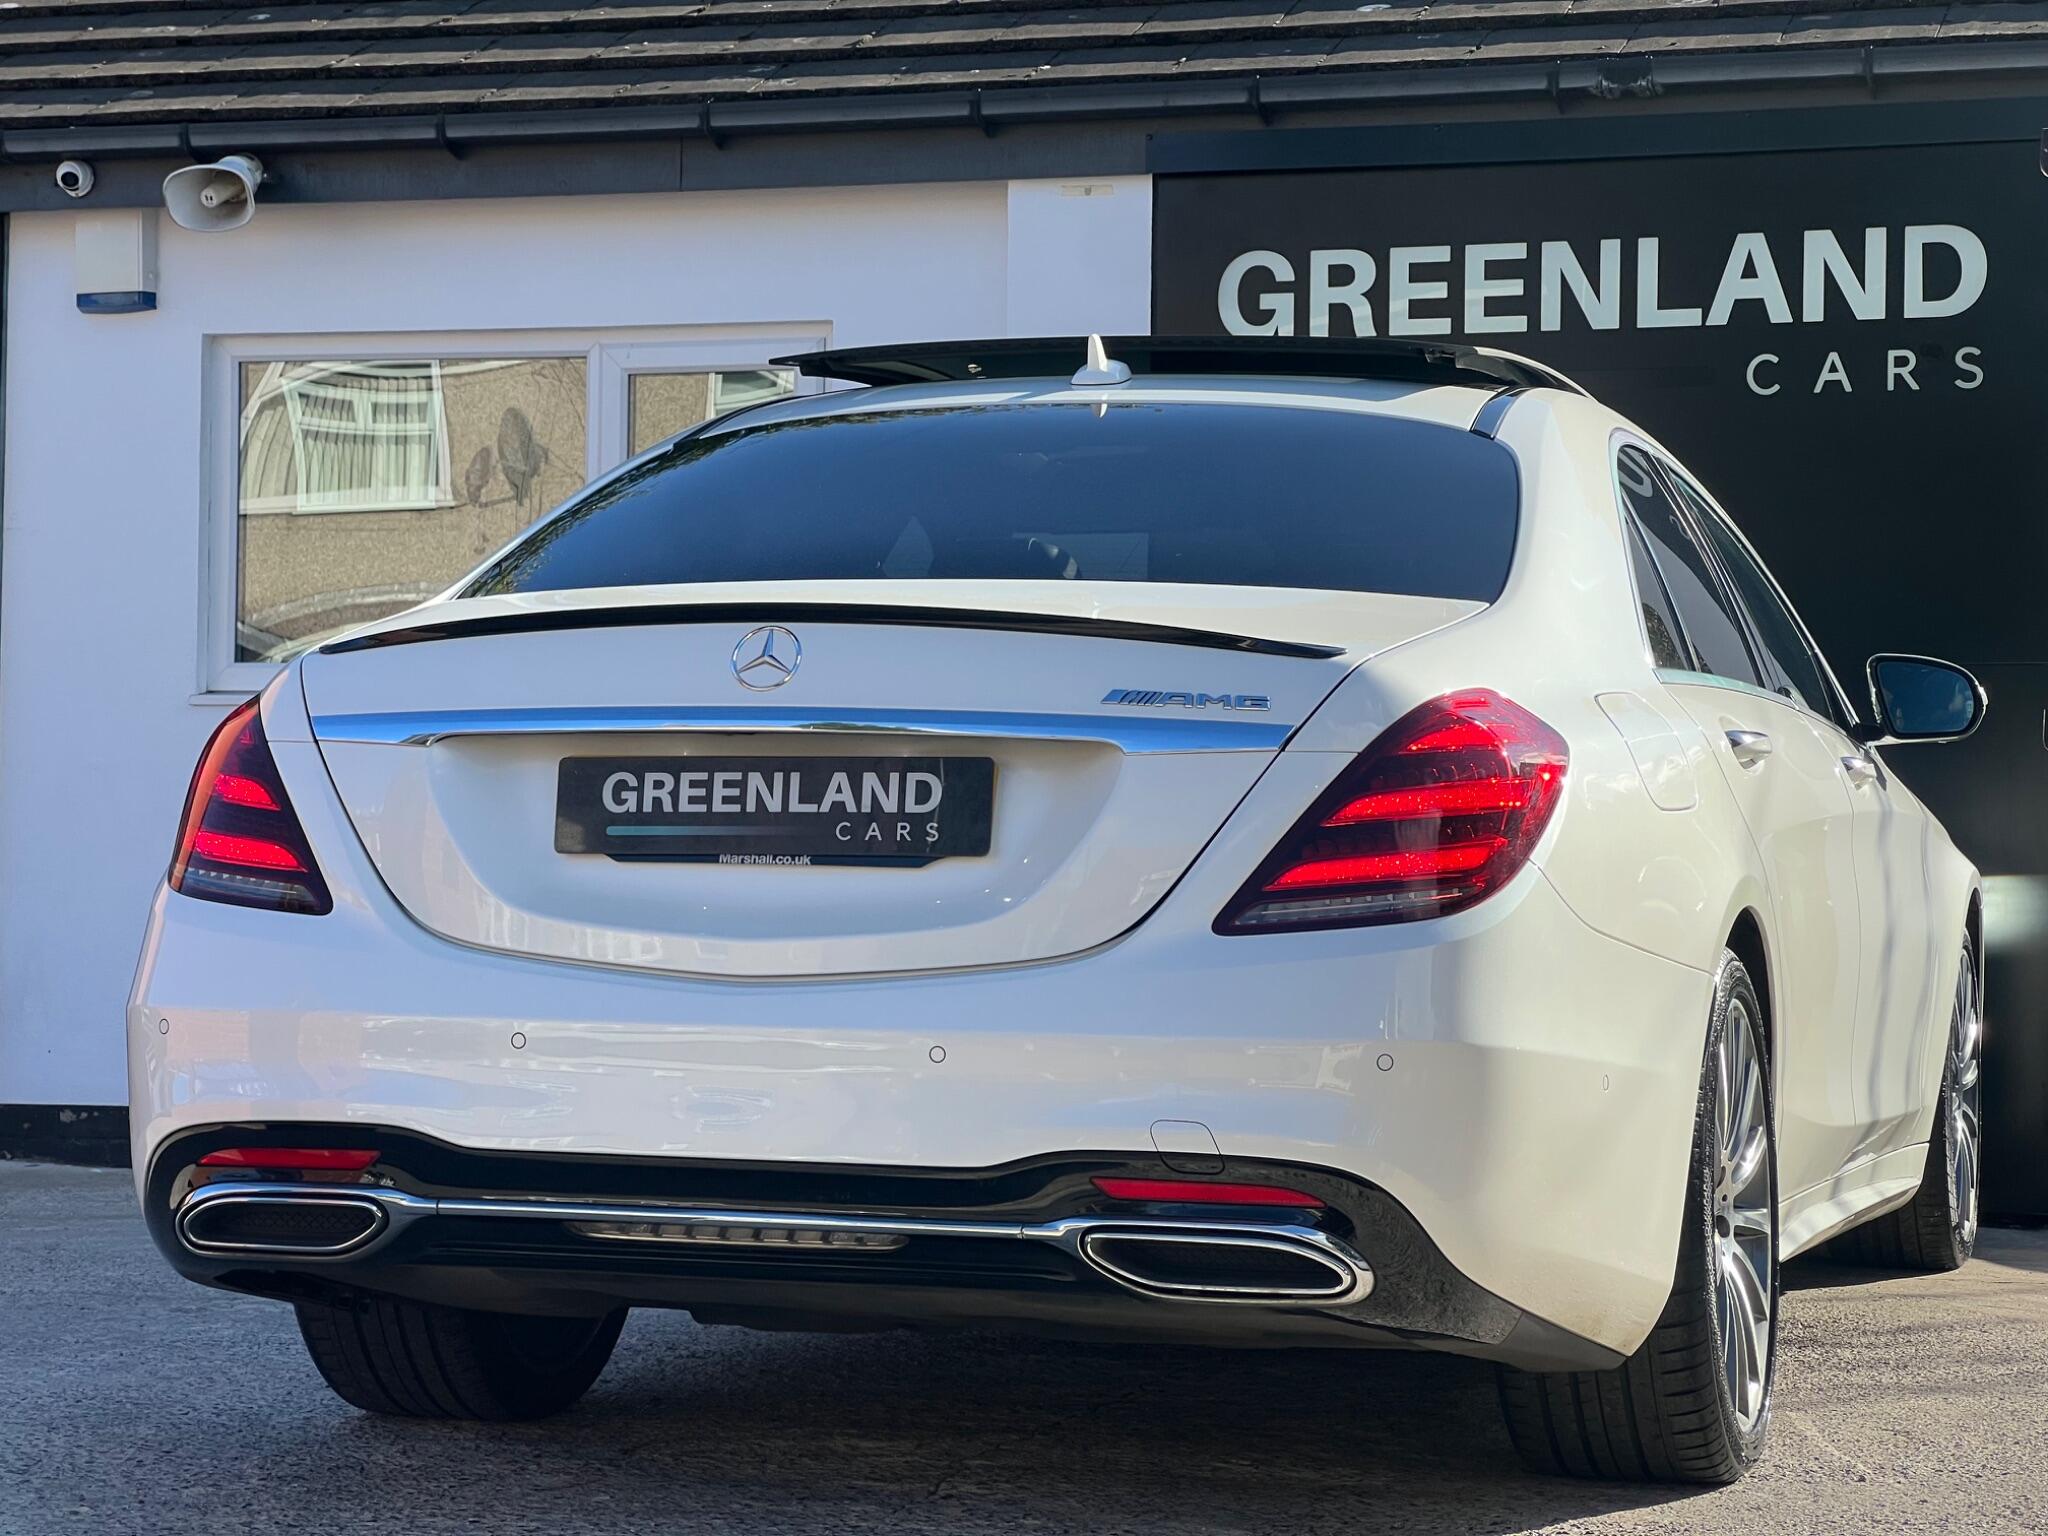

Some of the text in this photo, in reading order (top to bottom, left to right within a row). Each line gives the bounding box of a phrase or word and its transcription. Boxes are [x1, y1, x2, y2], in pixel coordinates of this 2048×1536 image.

[1217, 224, 1988, 336] GREENLAND
[1746, 346, 1985, 396] CARS
[1155, 692, 1271, 711] AMG
[601, 771, 943, 814] GREENLAND
[836, 822, 940, 841] CARS
[719, 853, 811, 865] Marshall.co.uk
